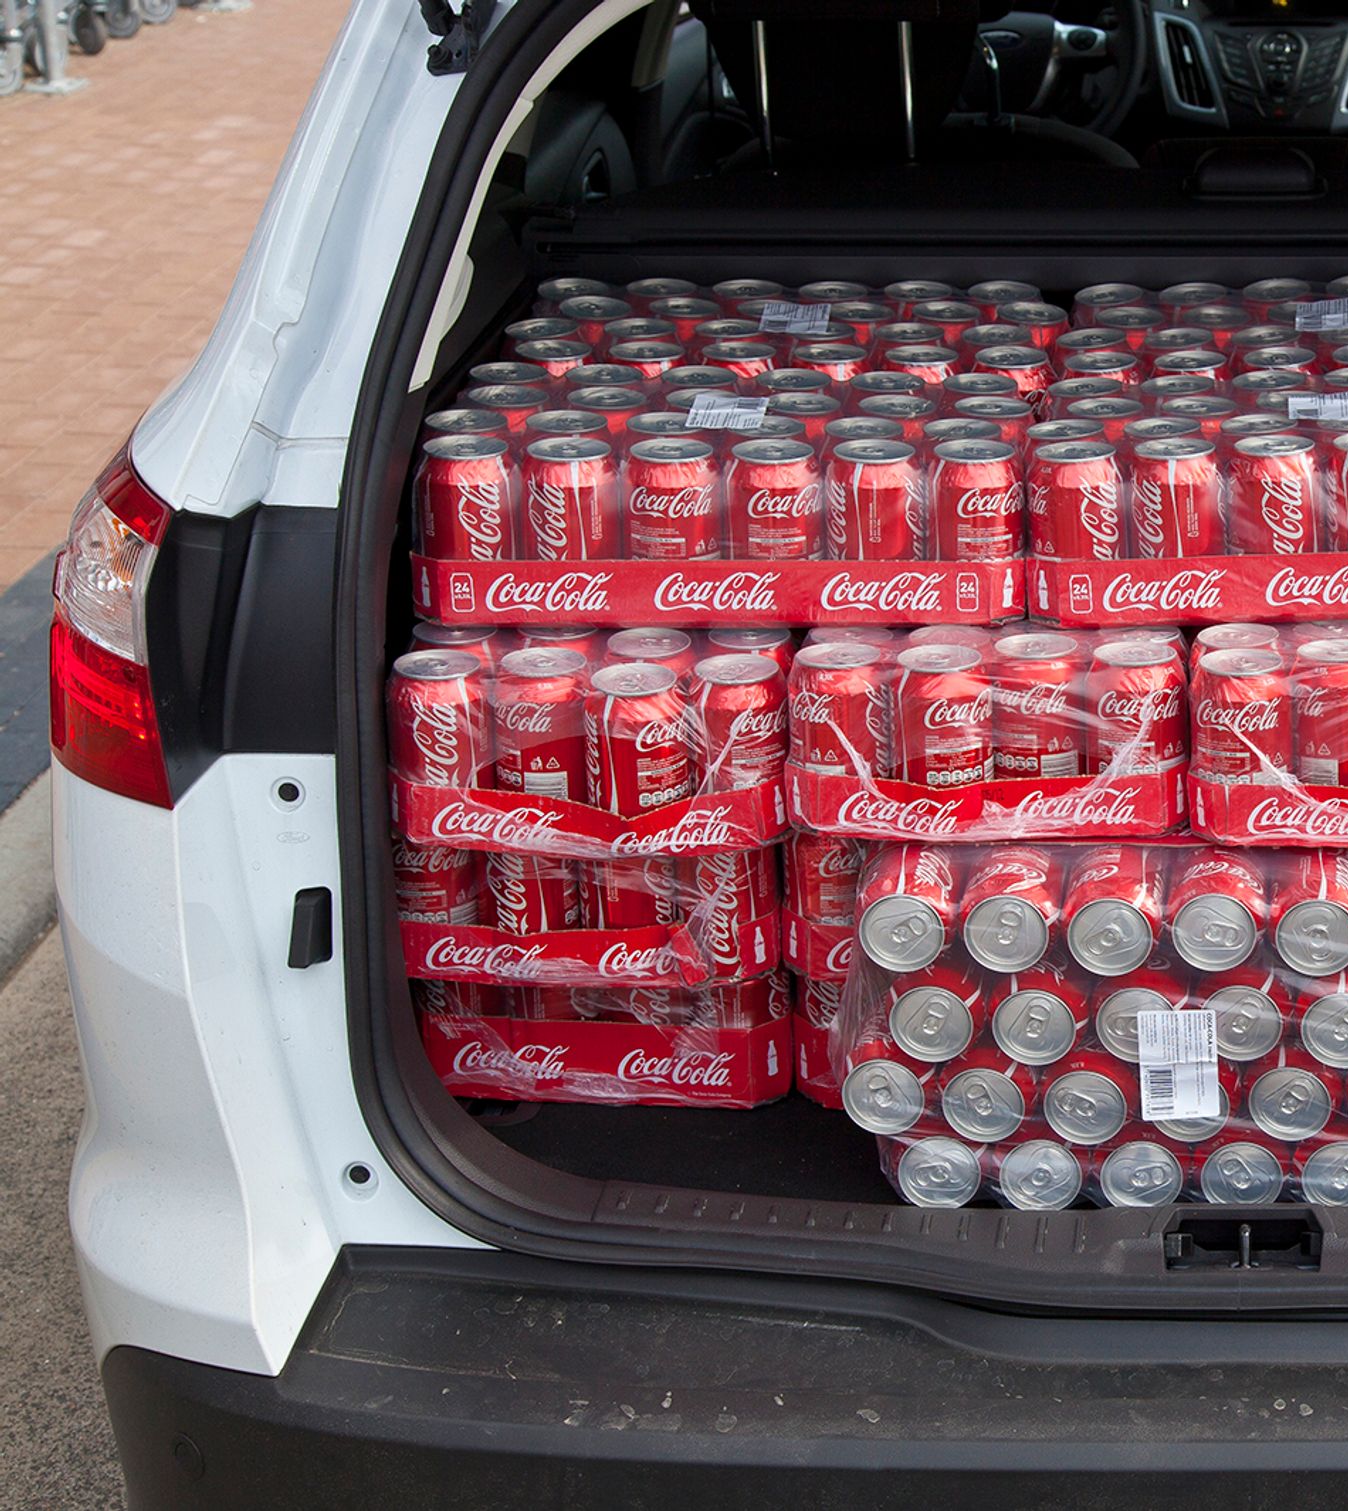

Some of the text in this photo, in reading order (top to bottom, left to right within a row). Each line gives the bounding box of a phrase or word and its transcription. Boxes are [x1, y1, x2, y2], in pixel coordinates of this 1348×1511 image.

[458, 473, 502, 560] a-Cola
[528, 472, 567, 560] a-Cola
[630, 486, 712, 518] Coca-Cola
[1080, 475, 1120, 560] a-Cola
[1131, 473, 1163, 559] a-Cola
[1261, 469, 1304, 554] a-Cola
[454, 582, 470, 593] 24
[486, 572, 614, 613] Coca-Cola
[654, 572, 781, 612] Coca-Cola
[820, 572, 947, 612] Coca-Cola
[960, 582, 975, 593] 24
[1073, 583, 1088, 595] 24
[1102, 569, 1227, 612] Coca-Cola
[496, 702, 553, 733] a-Cola
[1196, 697, 1281, 734] Coca-Cola
[410, 690, 458, 788] ca-Cola
[432, 802, 565, 847] Coca-Cola
[839, 790, 963, 834] Coca-Cola
[1014, 787, 1142, 828] Coca-Cola
[611, 804, 735, 857] Coca-Cola
[486, 850, 527, 935] ca-Cola
[426, 937, 548, 978] Coca-Cola
[453, 1041, 570, 1081] Coca-Cola
[617, 1049, 736, 1087] Coca-Cola
